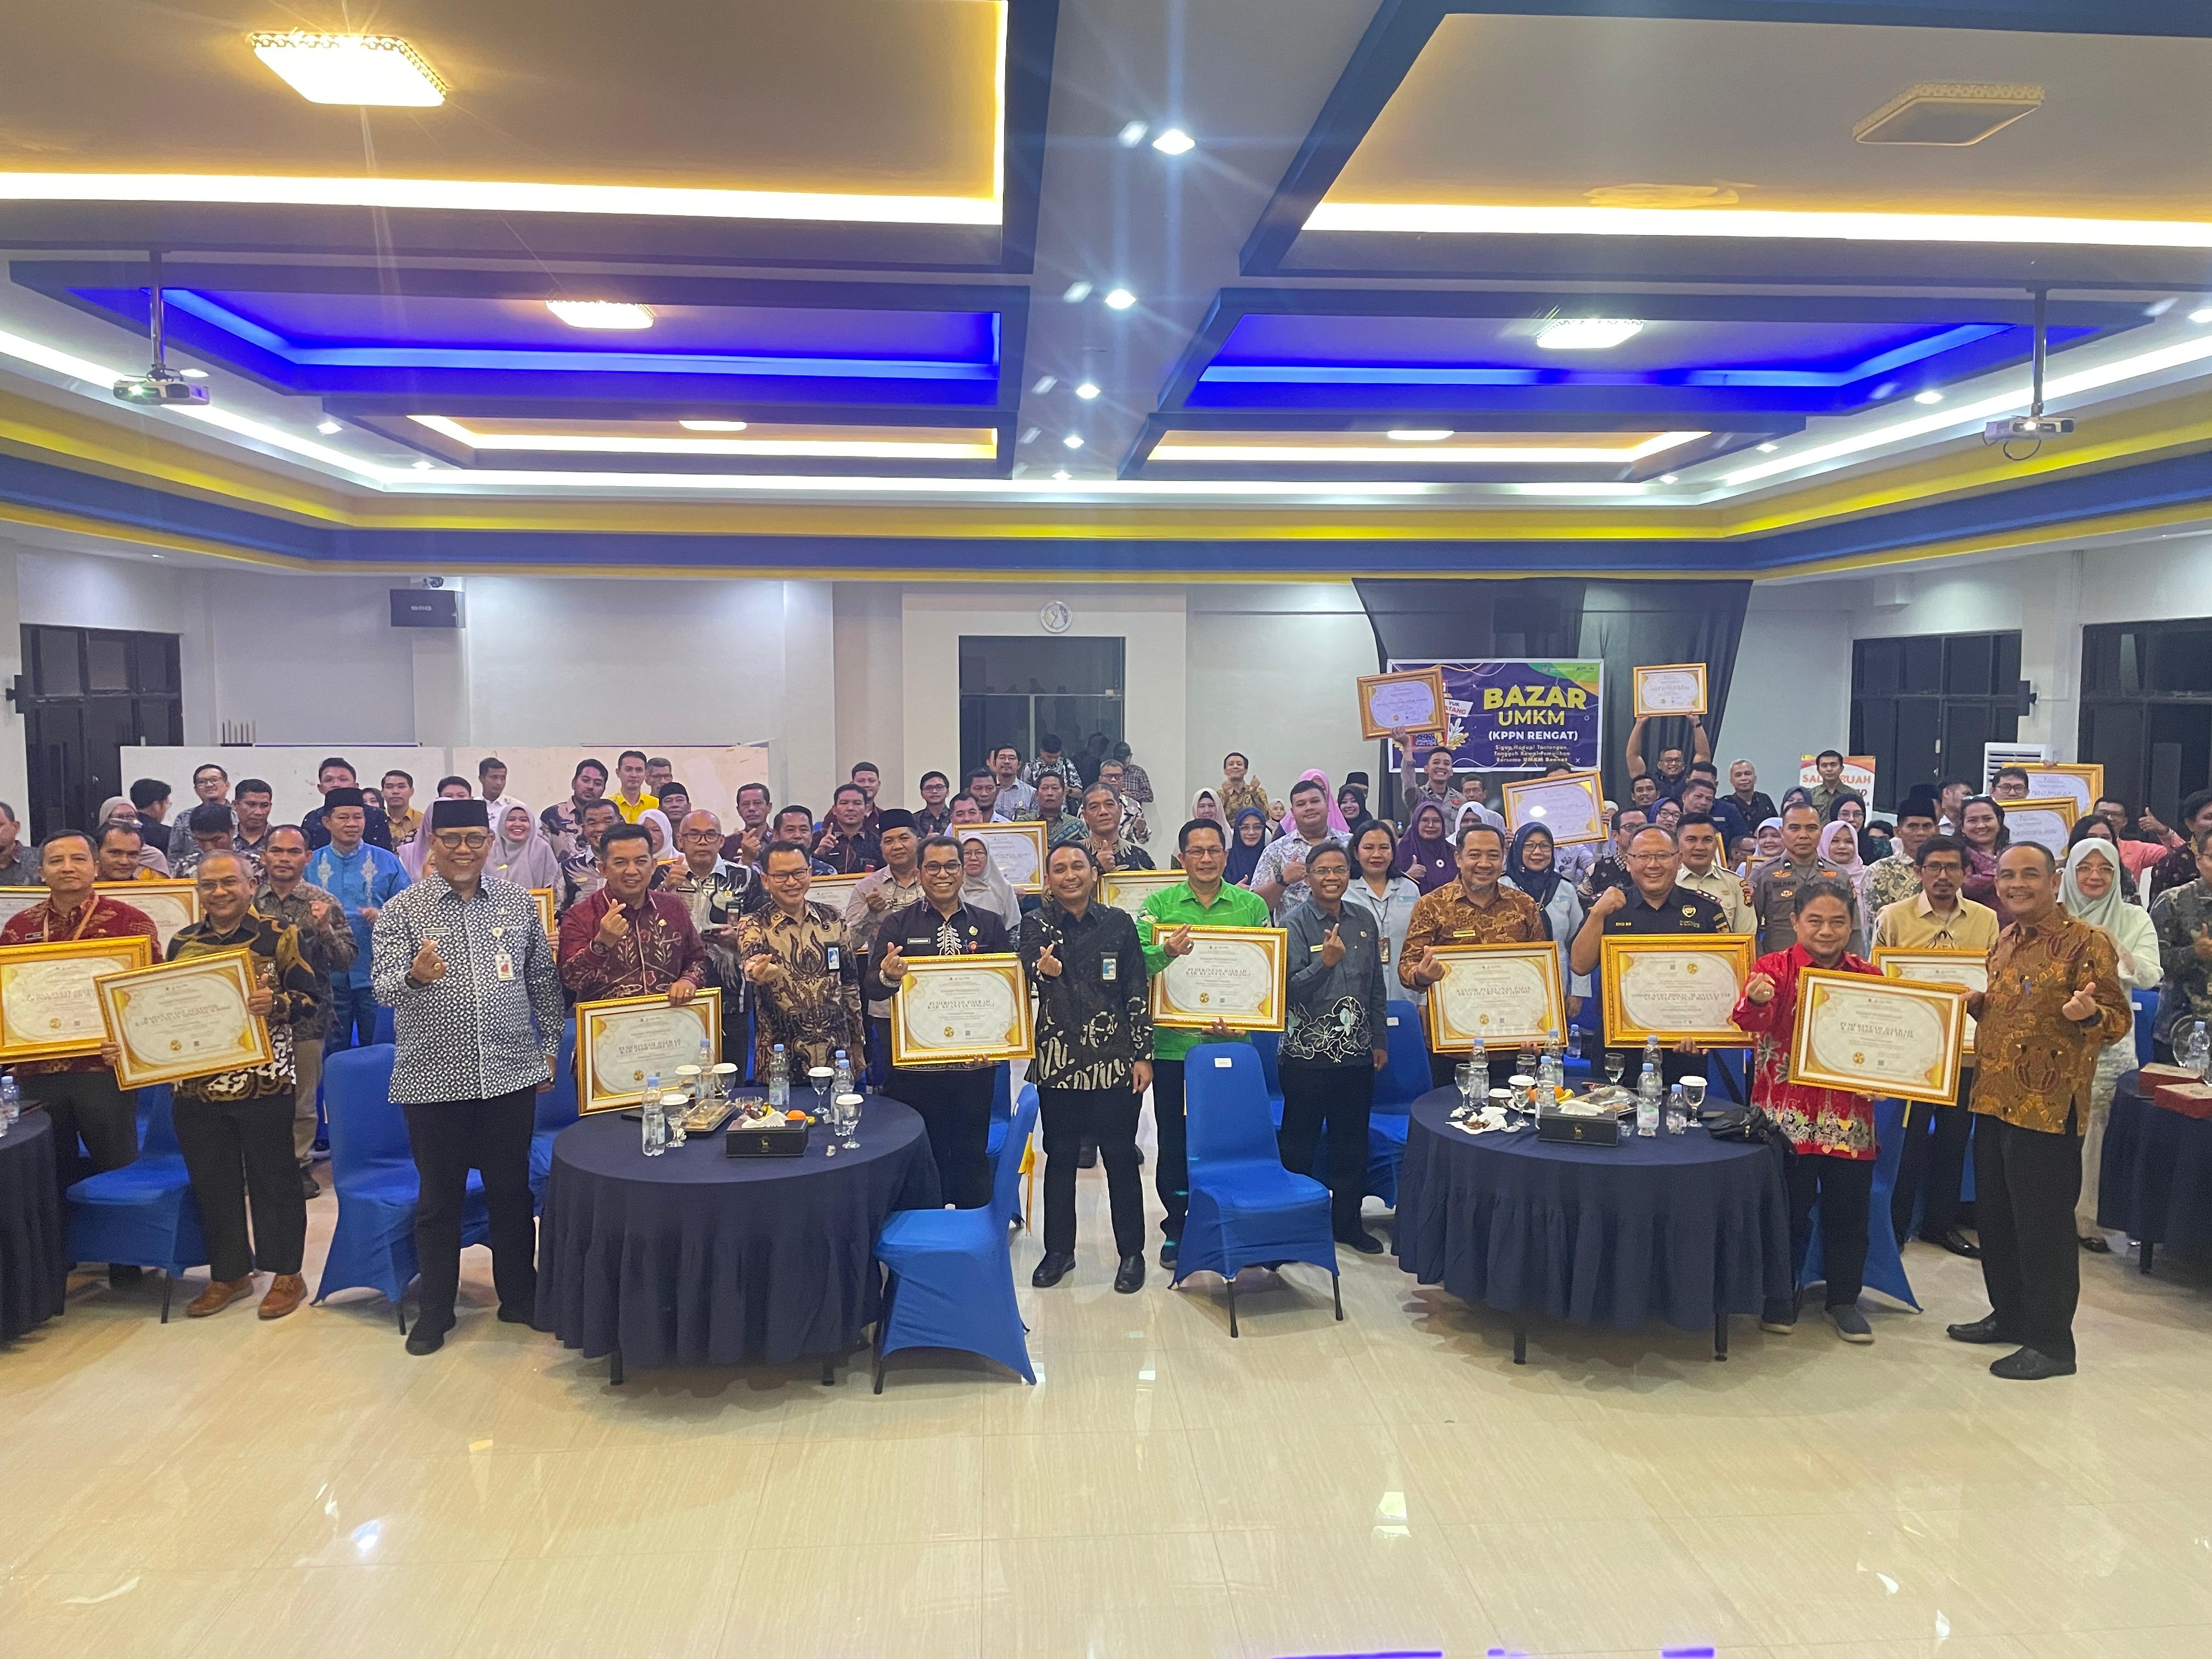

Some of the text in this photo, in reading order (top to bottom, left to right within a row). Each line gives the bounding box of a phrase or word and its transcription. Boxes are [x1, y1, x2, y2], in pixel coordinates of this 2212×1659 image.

[1483, 685, 1587, 710] BAZAR
[1445, 706, 1466, 714] ATANG
[1498, 709, 1565, 726] UMKM
[1488, 731, 1578, 741] (KPPN RENGAT)
[1802, 774, 1823, 783] SAL
